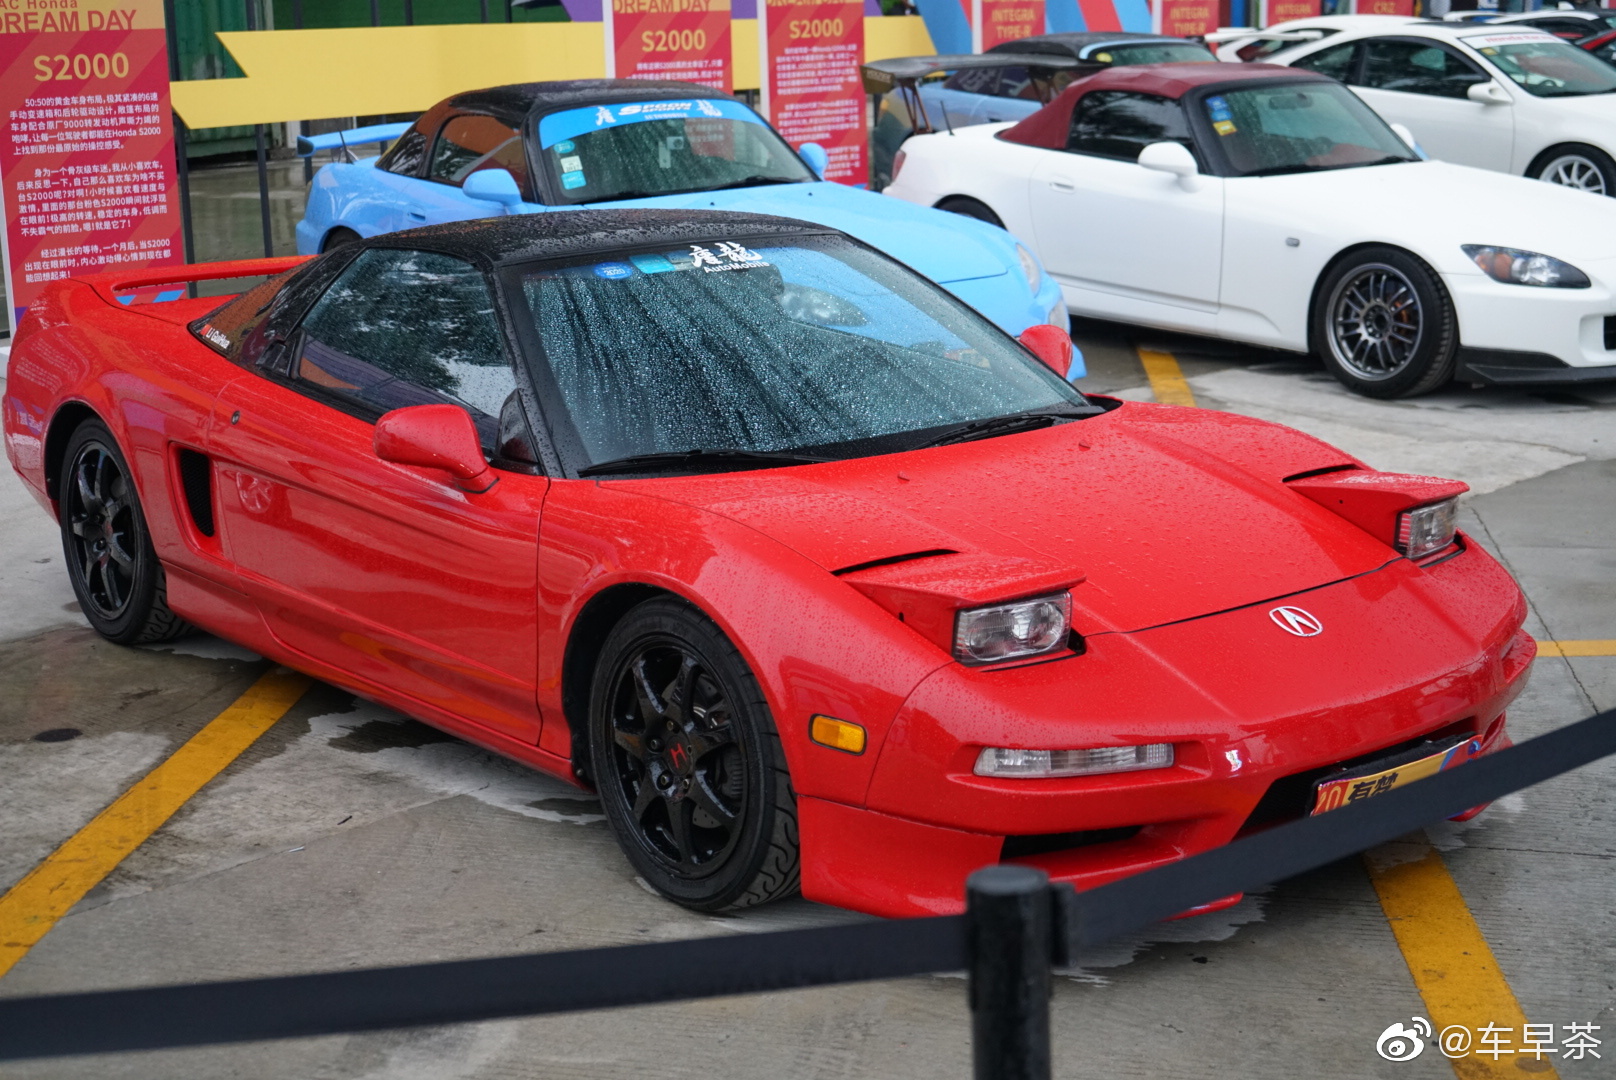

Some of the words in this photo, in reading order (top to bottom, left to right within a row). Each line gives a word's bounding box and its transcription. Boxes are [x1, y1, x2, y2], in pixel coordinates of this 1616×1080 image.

[27, 0, 78, 9] Honda
[87, 9, 137, 31] DAY
[992, 8, 1035, 22] INTEGRA
[1170, 6, 1209, 20] INTEGRA
[789, 18, 844, 39] S2000
[641, 29, 707, 52] S2000
[34, 52, 130, 82] S2000
[139, 127, 161, 136] S2000
[603, 268, 626, 276] 2020
[704, 261, 770, 274] AutoMobile
